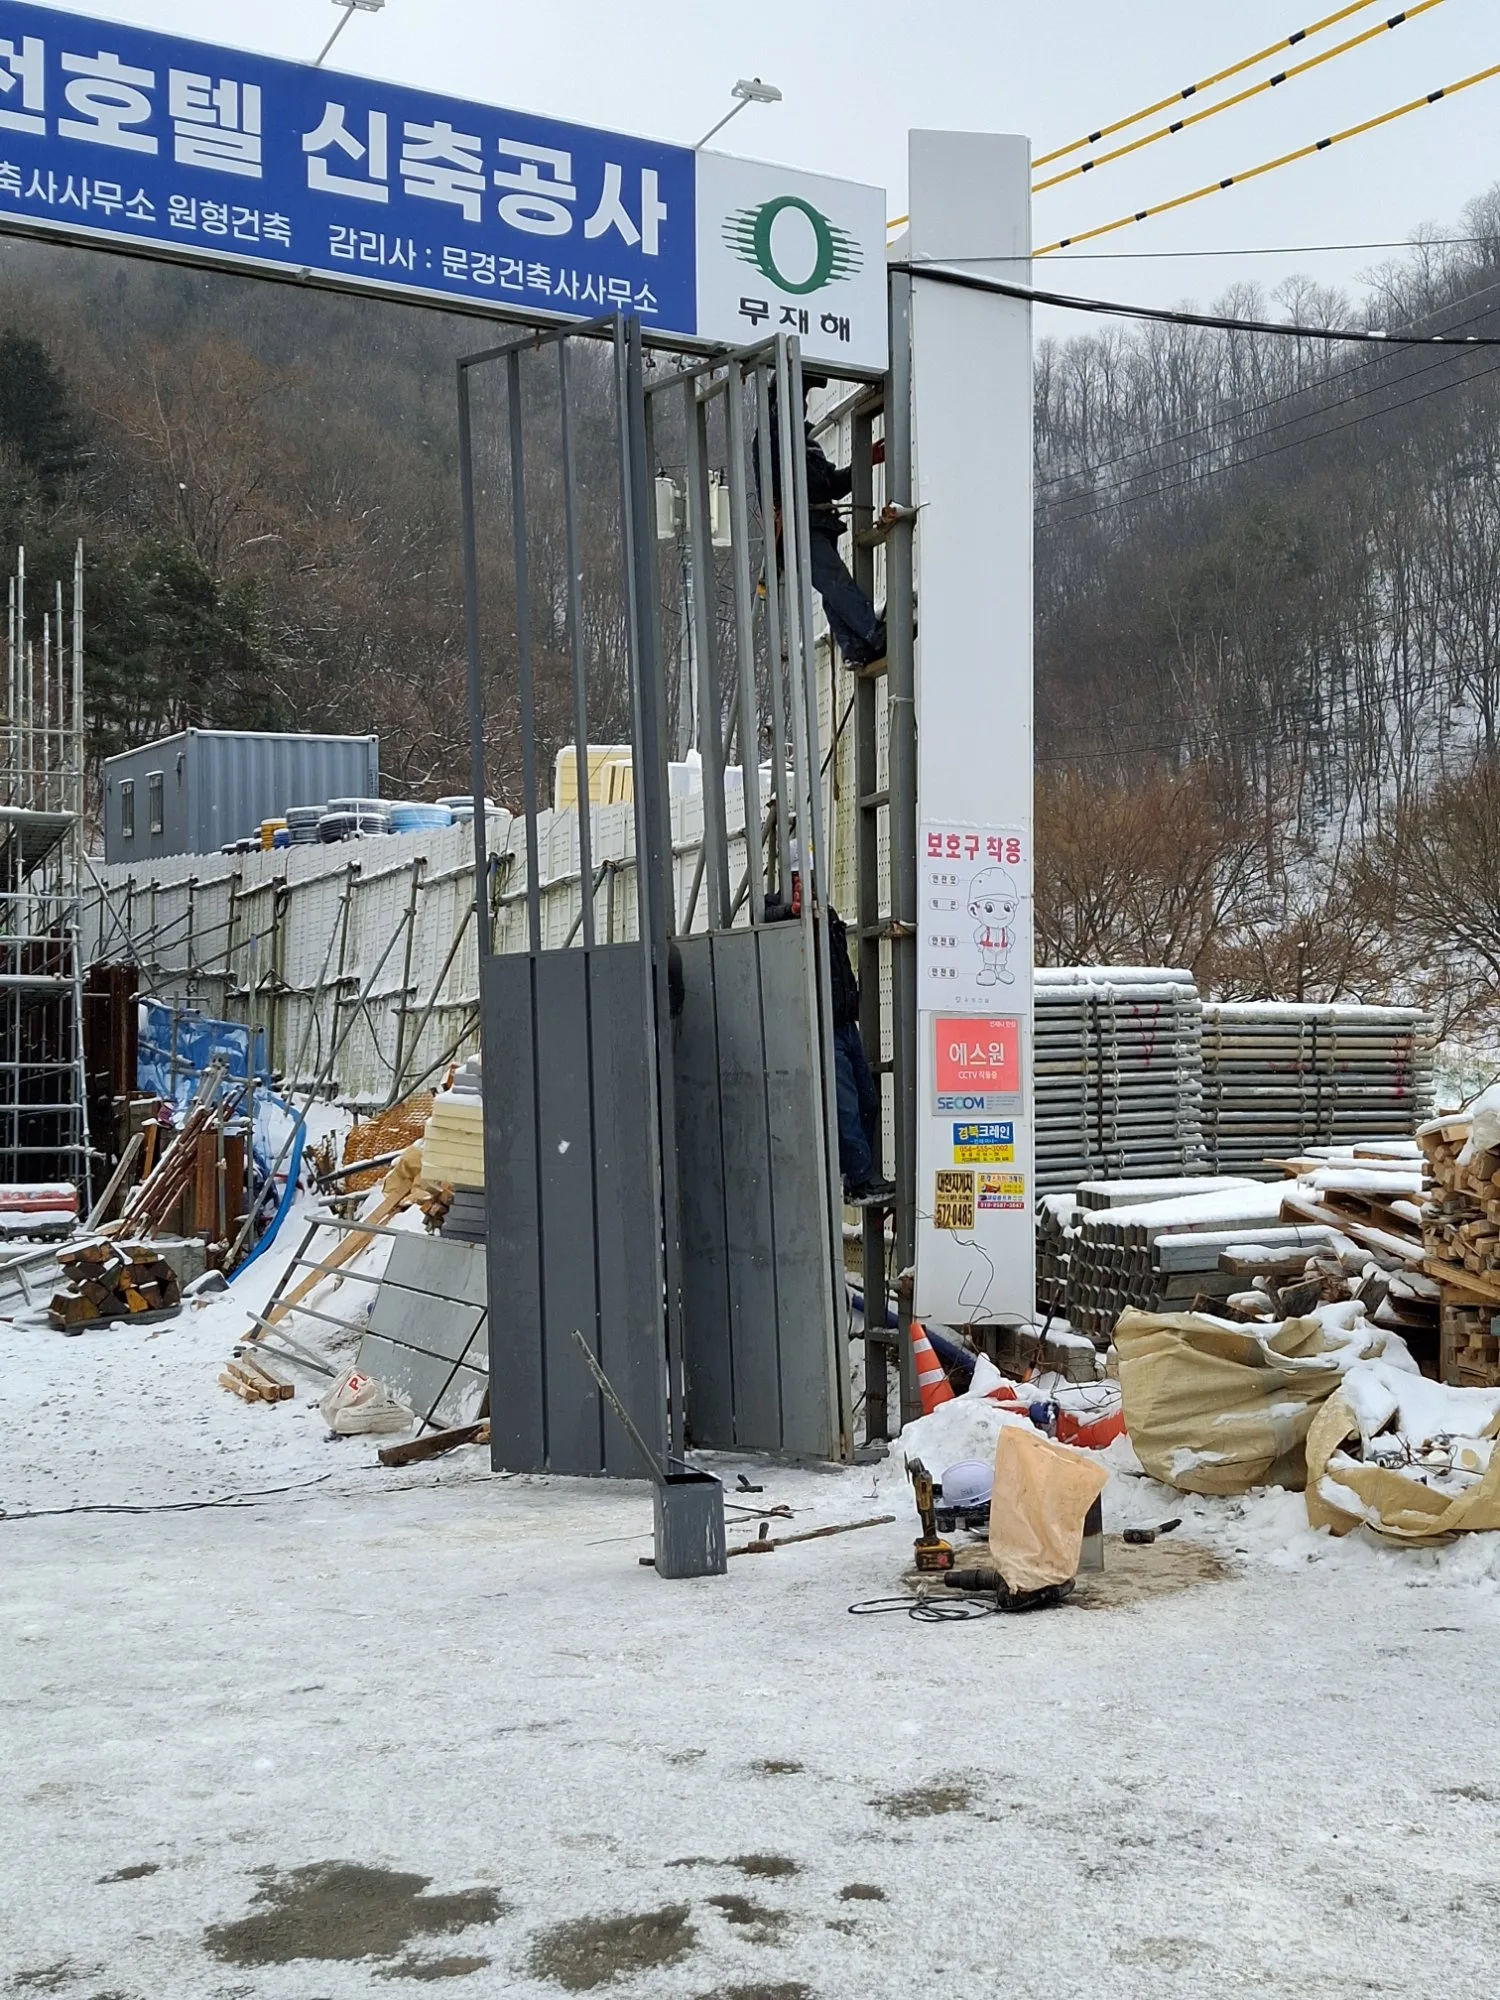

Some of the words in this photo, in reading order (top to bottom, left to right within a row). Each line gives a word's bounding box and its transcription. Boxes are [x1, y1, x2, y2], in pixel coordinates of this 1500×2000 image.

[302, 101, 668, 256] 신축공사
[168, 194, 292, 248] 원형건축
[328, 224, 417, 270] 감리사
[441, 246, 659, 314] 문경건축사사무소
[927, 832, 980, 861] 보호구
[986, 836, 1021, 865] 착용
[948, 1042, 1005, 1066] 에스원
[958, 1071, 978, 1079] CCTV
[937, 1096, 985, 1109] SECOM
[958, 1125, 1010, 1139] 경북크레인
[937, 1172, 973, 1193] 대한지게차
